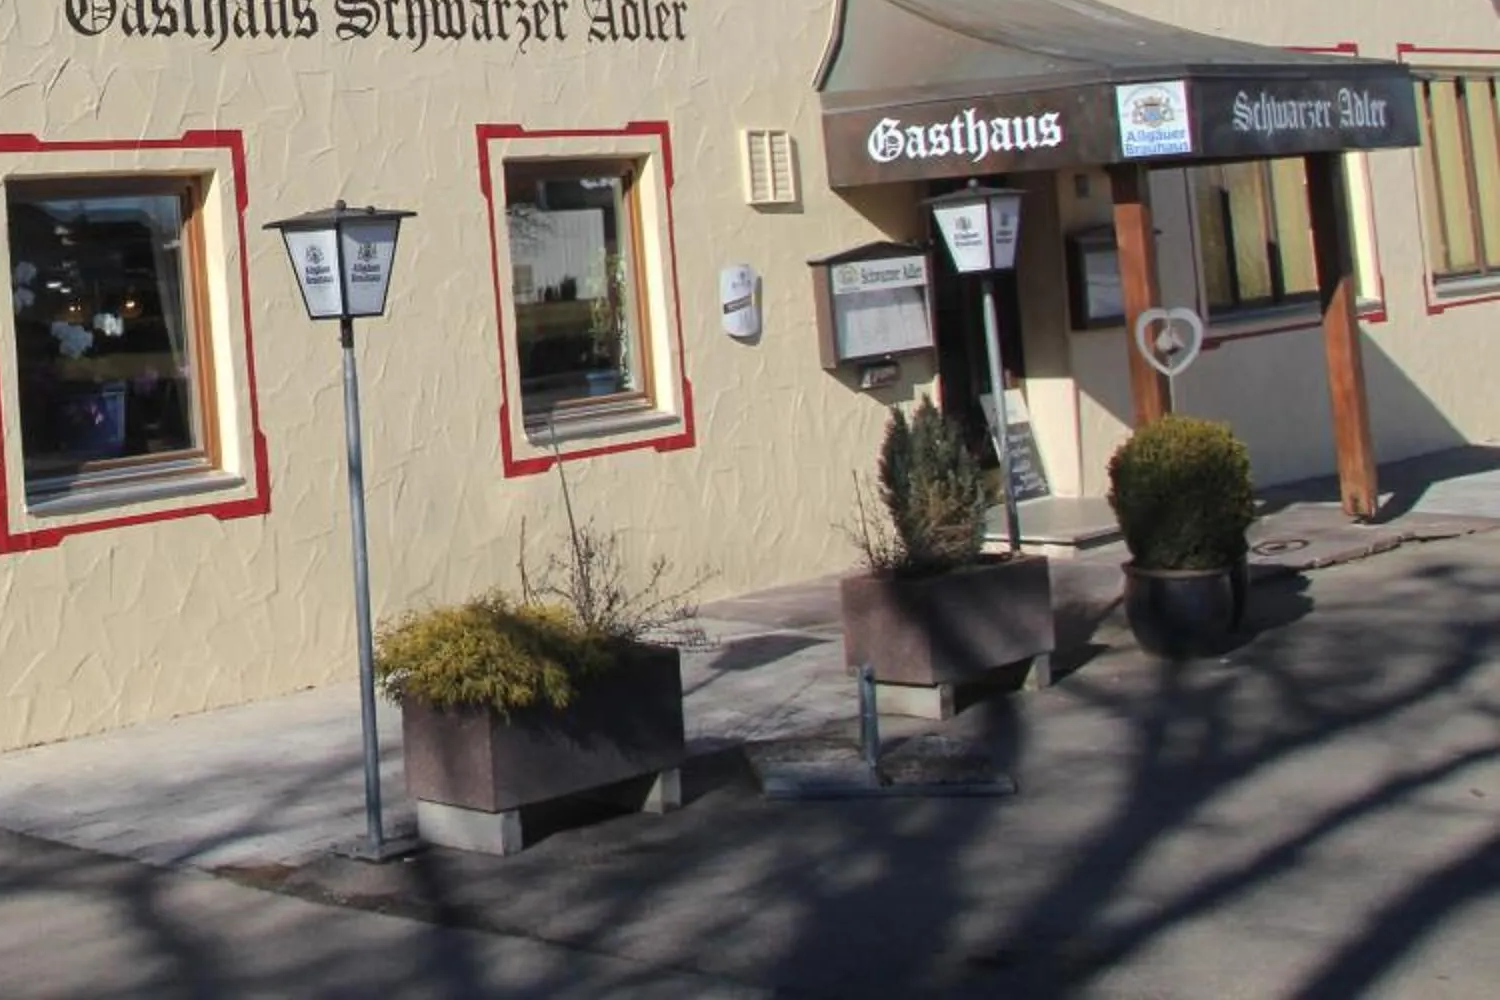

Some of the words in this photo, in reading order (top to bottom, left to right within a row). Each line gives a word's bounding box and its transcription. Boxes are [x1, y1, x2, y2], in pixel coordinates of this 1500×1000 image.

[867, 107, 1062, 163] Gasthaus
[1232, 90, 1332, 137] Schwarzer
[1338, 87, 1388, 128] Adler
